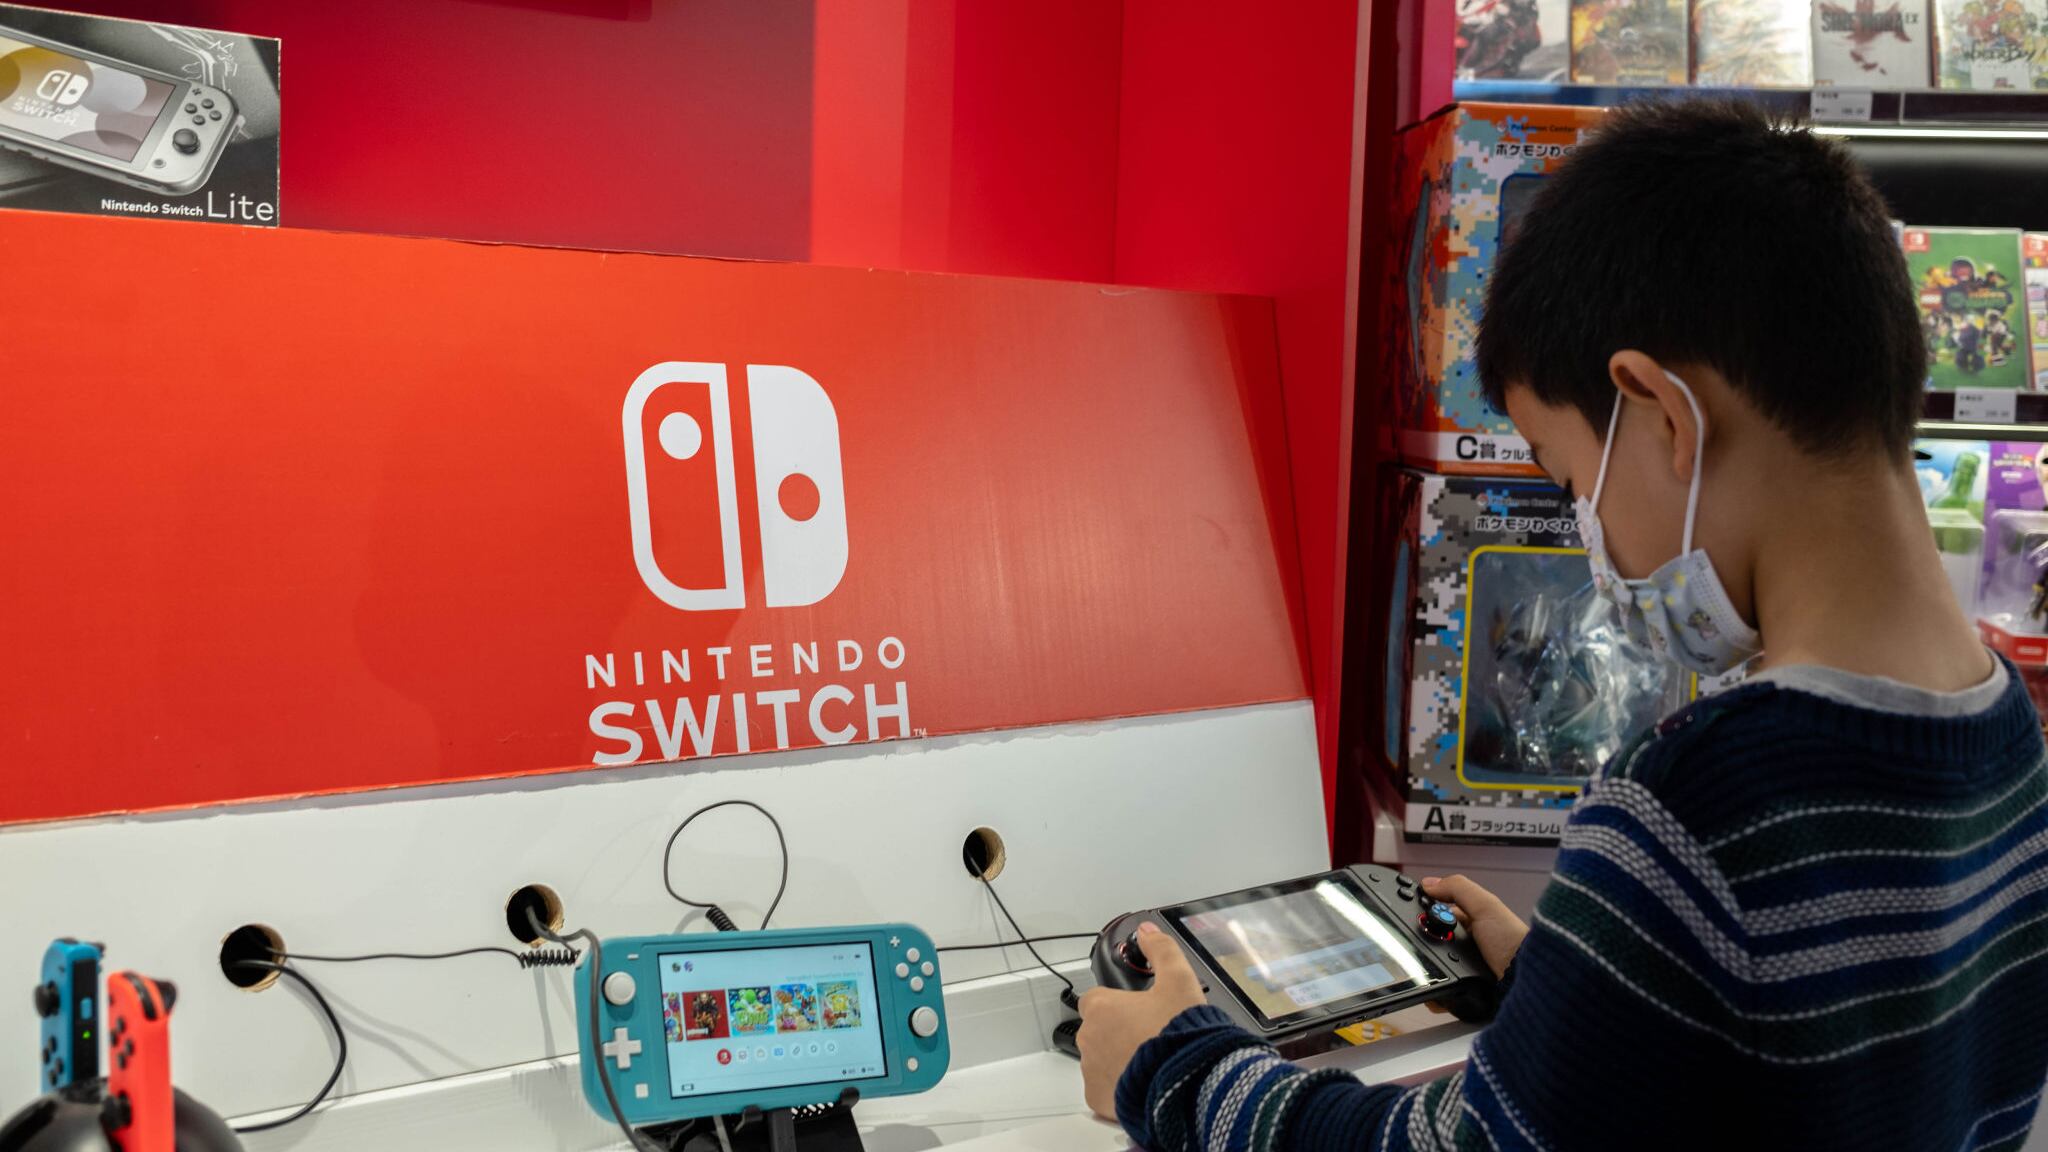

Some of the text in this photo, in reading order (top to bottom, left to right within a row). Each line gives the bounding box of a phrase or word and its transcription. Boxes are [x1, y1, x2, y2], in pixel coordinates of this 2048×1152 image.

[11, 101, 78, 127] SWITCH
[101, 190, 274, 221] Nintendo Switch Lite
[585, 636, 906, 688] NINTENDO
[588, 681, 911, 766] SWITCH
[1424, 806, 1466, 831] A賞
